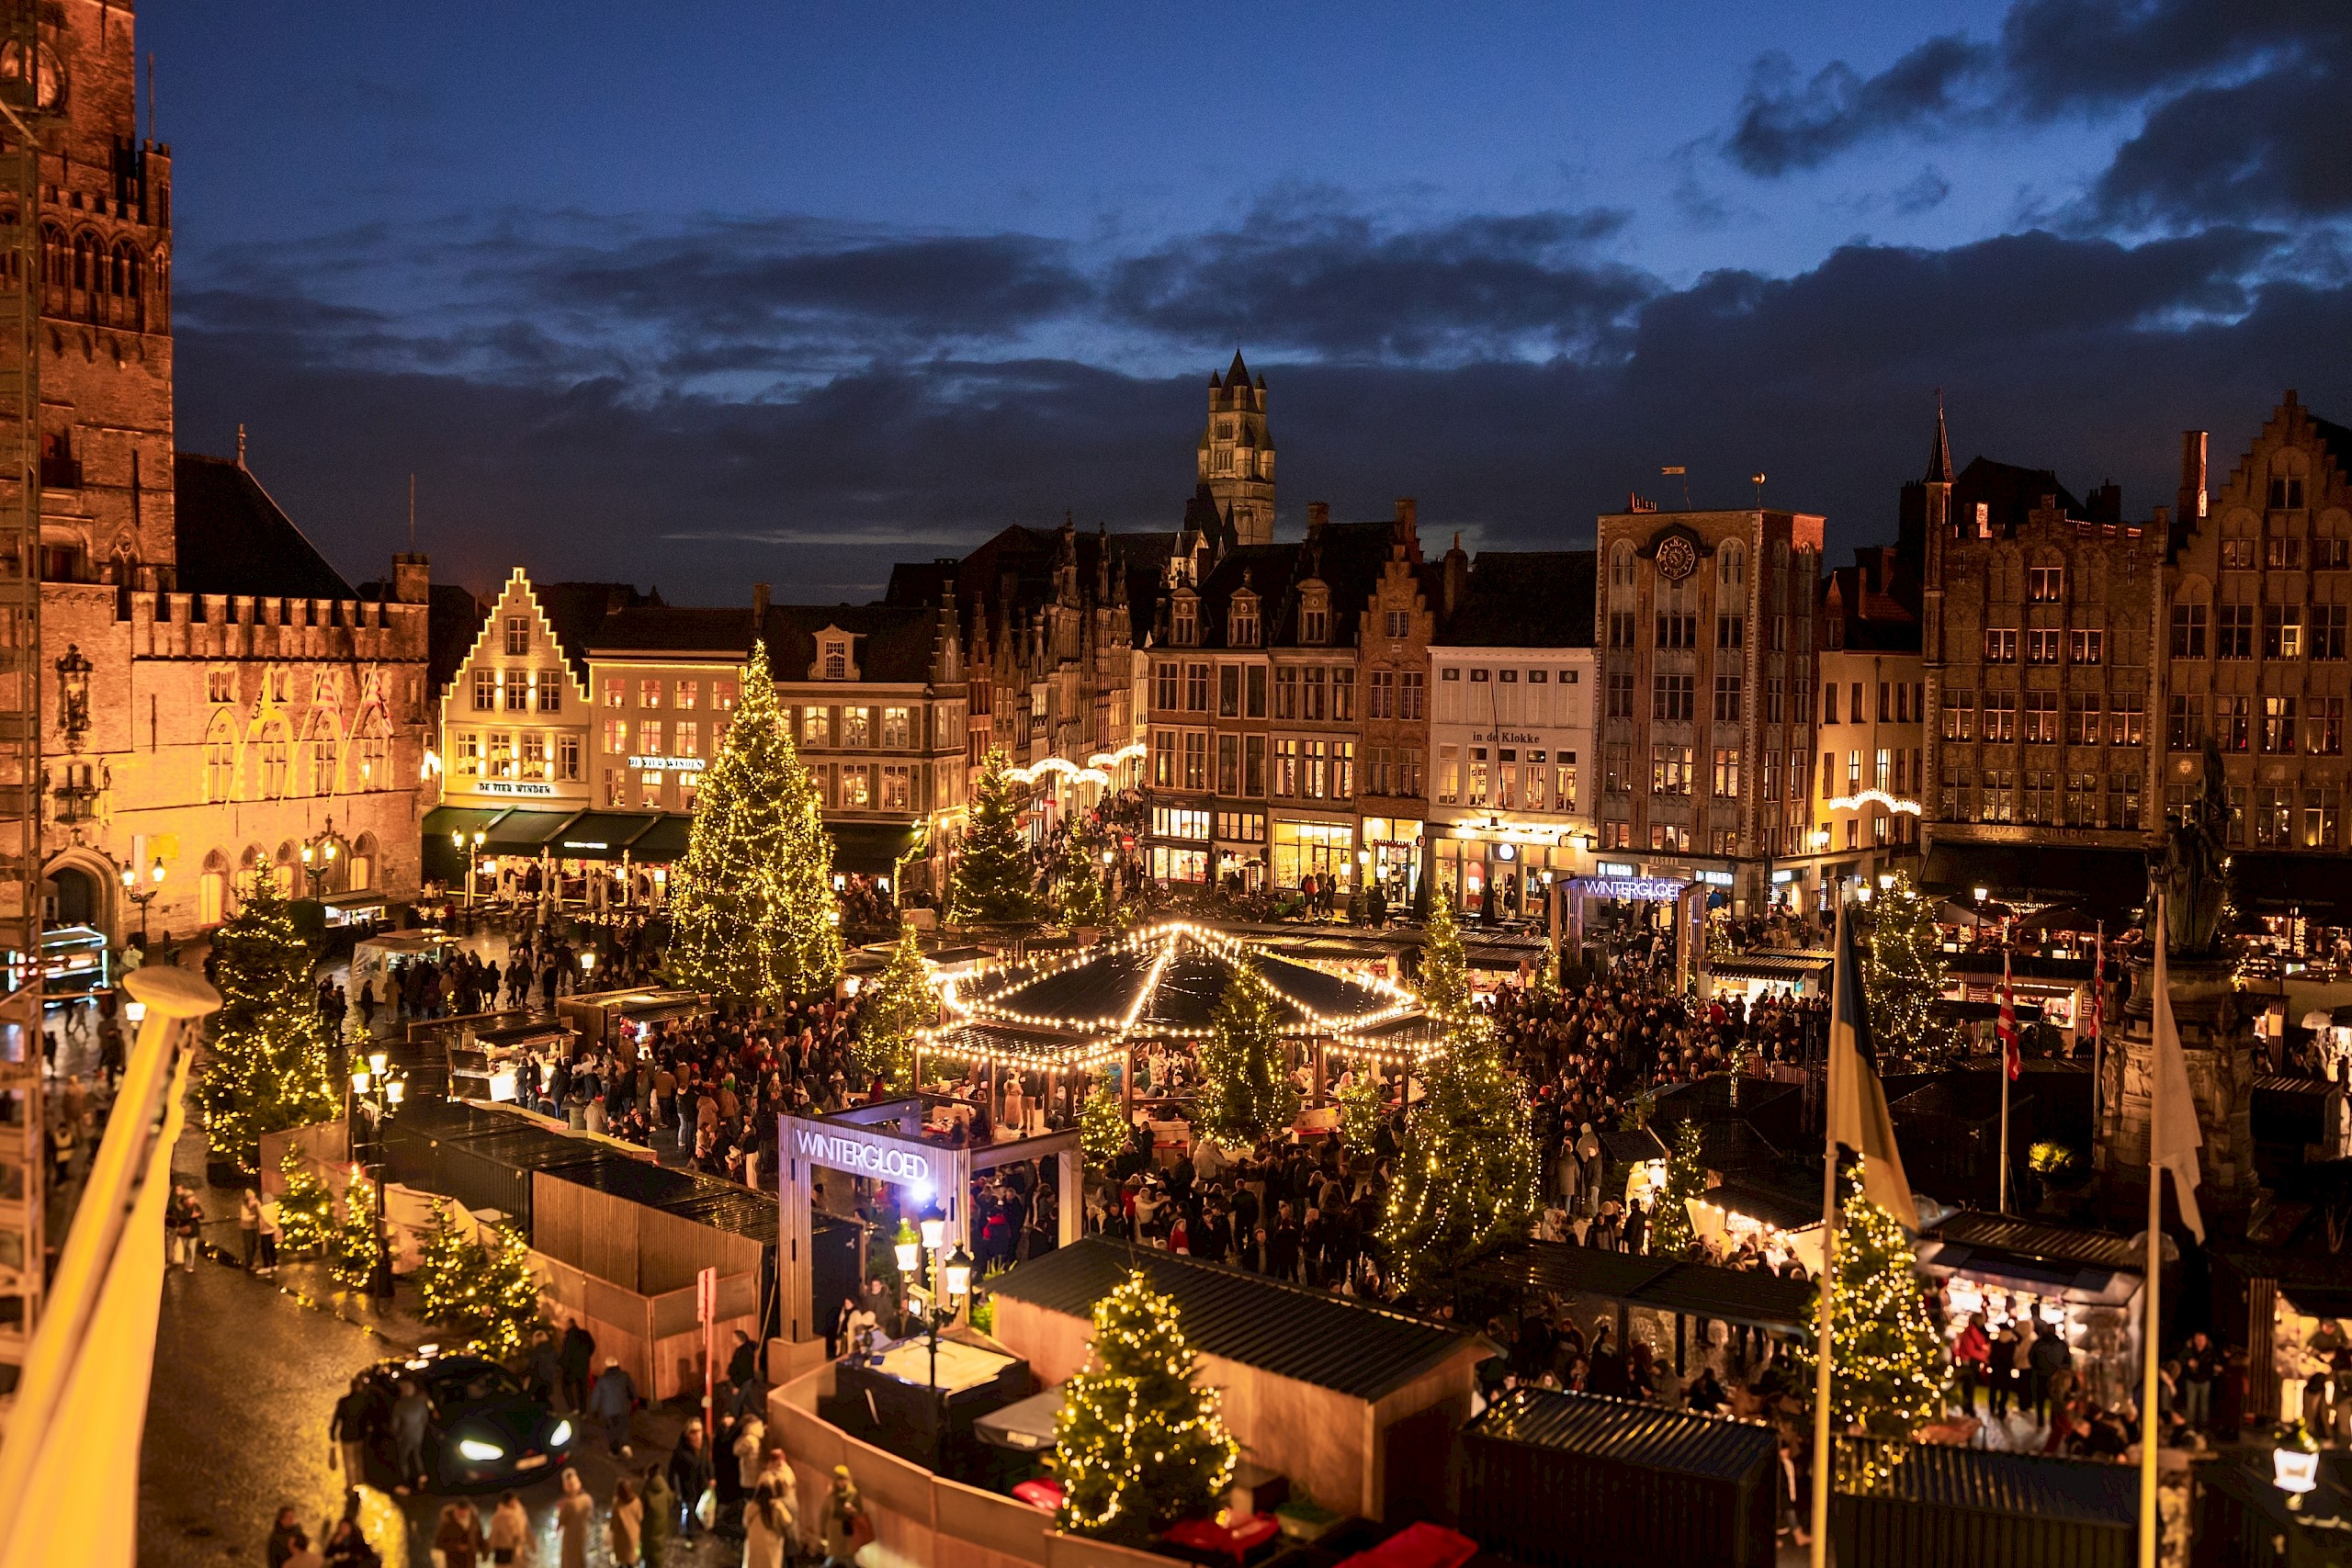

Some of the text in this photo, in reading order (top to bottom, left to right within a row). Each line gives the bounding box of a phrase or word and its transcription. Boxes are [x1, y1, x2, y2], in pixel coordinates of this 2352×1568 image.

[1473, 731, 1540, 744] in de Klokke
[479, 784, 550, 795] DE VIER WINDEN
[1649, 856, 1679, 866] WASBAR
[796, 1129, 929, 1181] WINTERGLOED
